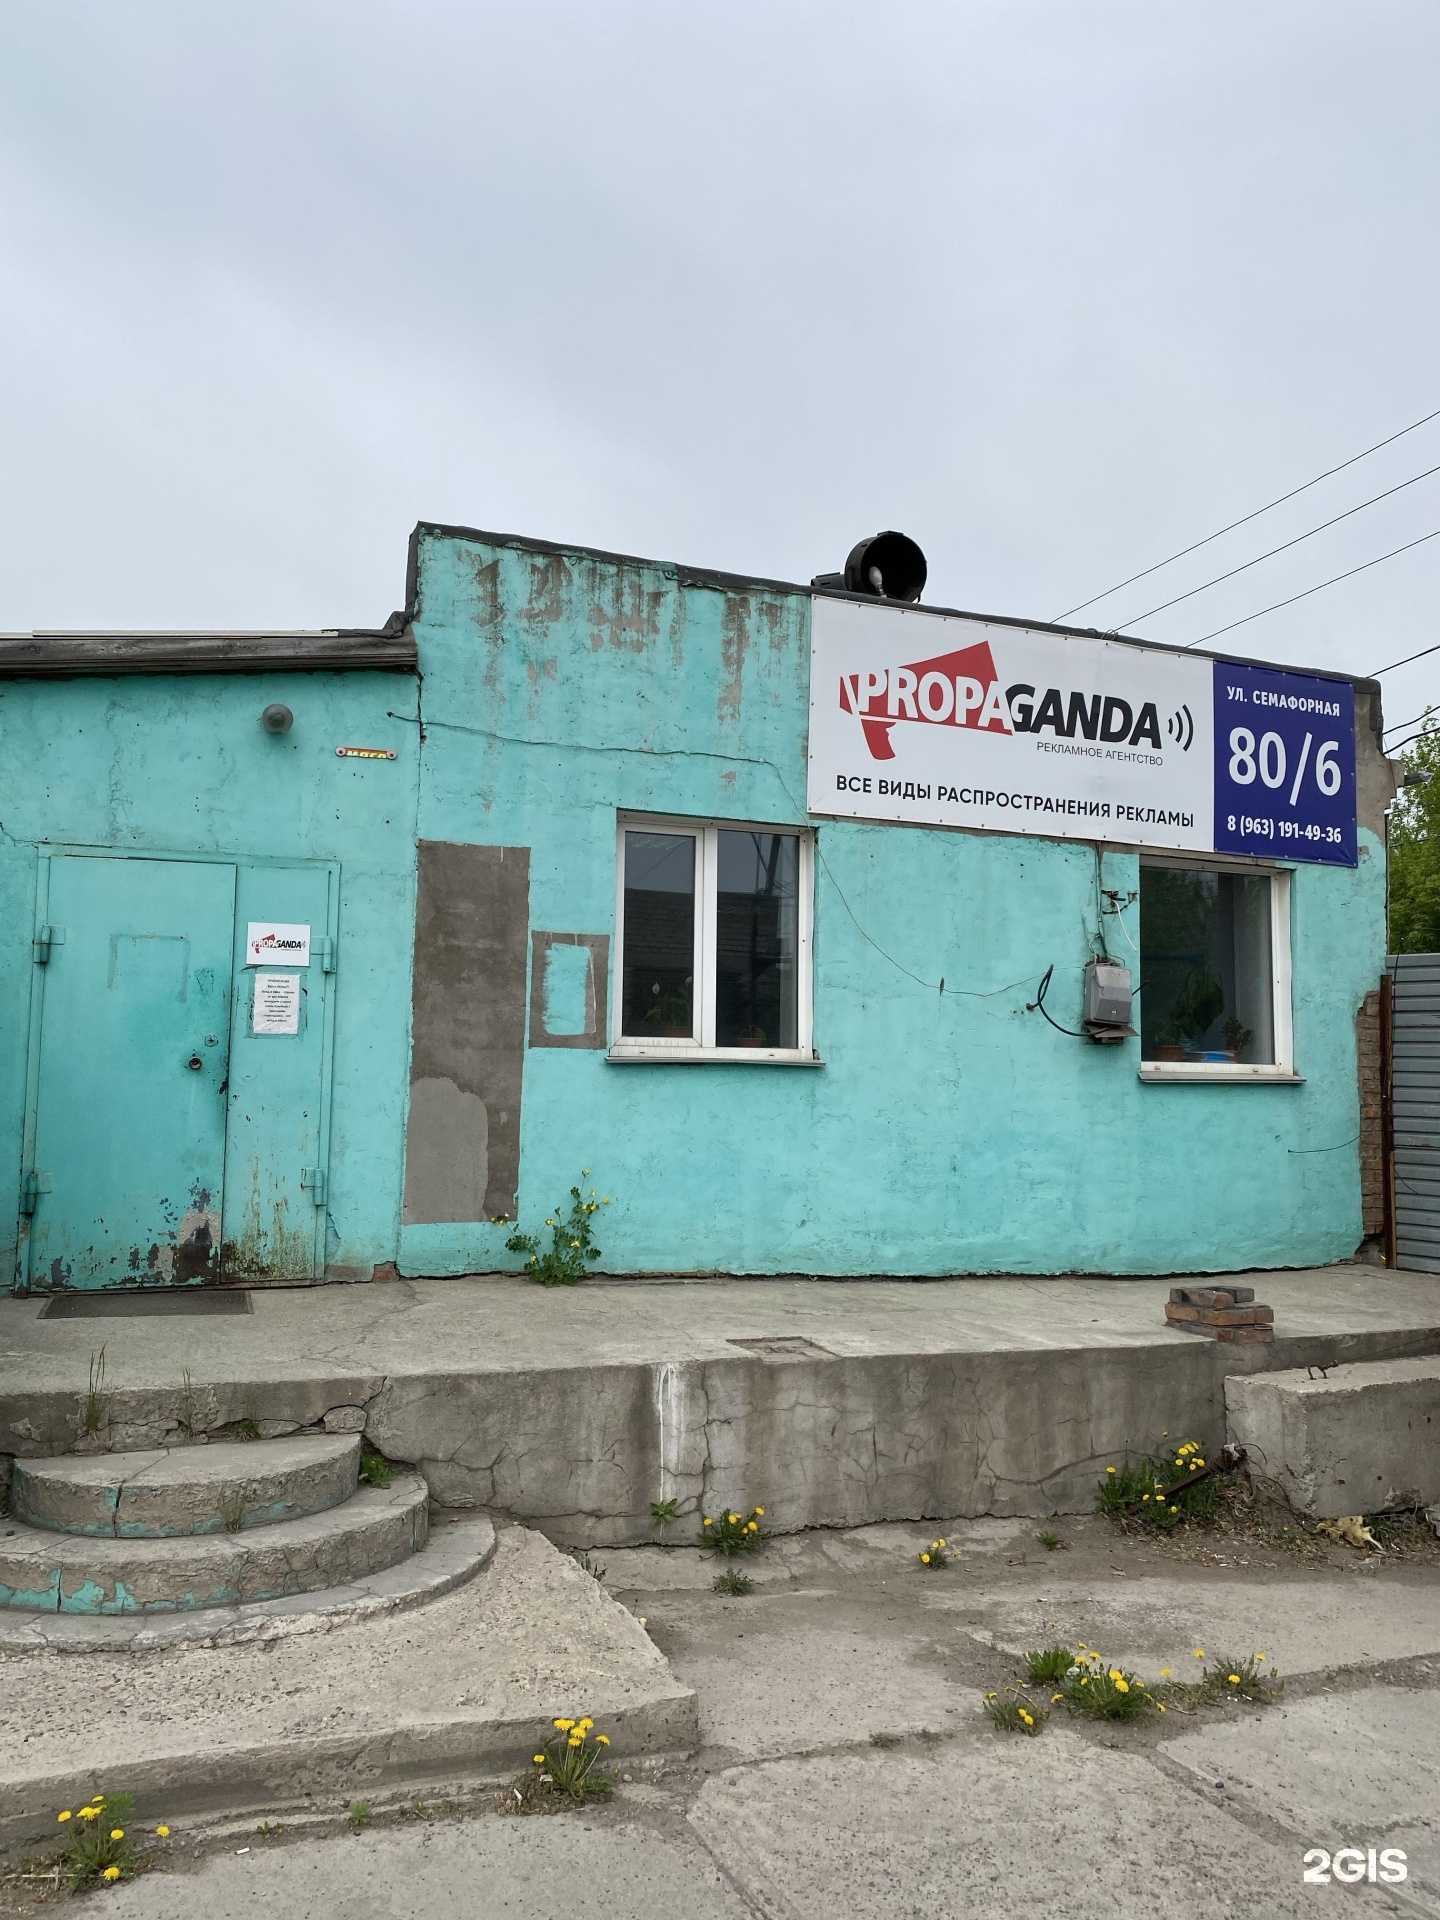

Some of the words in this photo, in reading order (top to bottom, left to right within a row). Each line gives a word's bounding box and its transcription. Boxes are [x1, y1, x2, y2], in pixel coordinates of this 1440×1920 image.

[857, 667, 1162, 750] PROPAGANDA
[1227, 685, 1248, 702] УЛ.
[1252, 690, 1340, 717] СЕМАФОРНАЯ
[1036, 741, 1102, 758] РЕКЛАМНОЕ
[1105, 750, 1163, 766] АГЕНТСТВО
[1228, 726, 1342, 807] 80/6
[836, 775, 872, 793] ВСЕ
[878, 779, 931, 800] ВИДЫ
[937, 785, 1111, 818] РАСПРОСТРАНЕНИЯ
[1116, 805, 1194, 828] РЕКЛАМЫ
[1227, 815, 1236, 831] 8
[1240, 816, 1274, 839] (963)
[1278, 821, 1342, 843] 191-49-36
